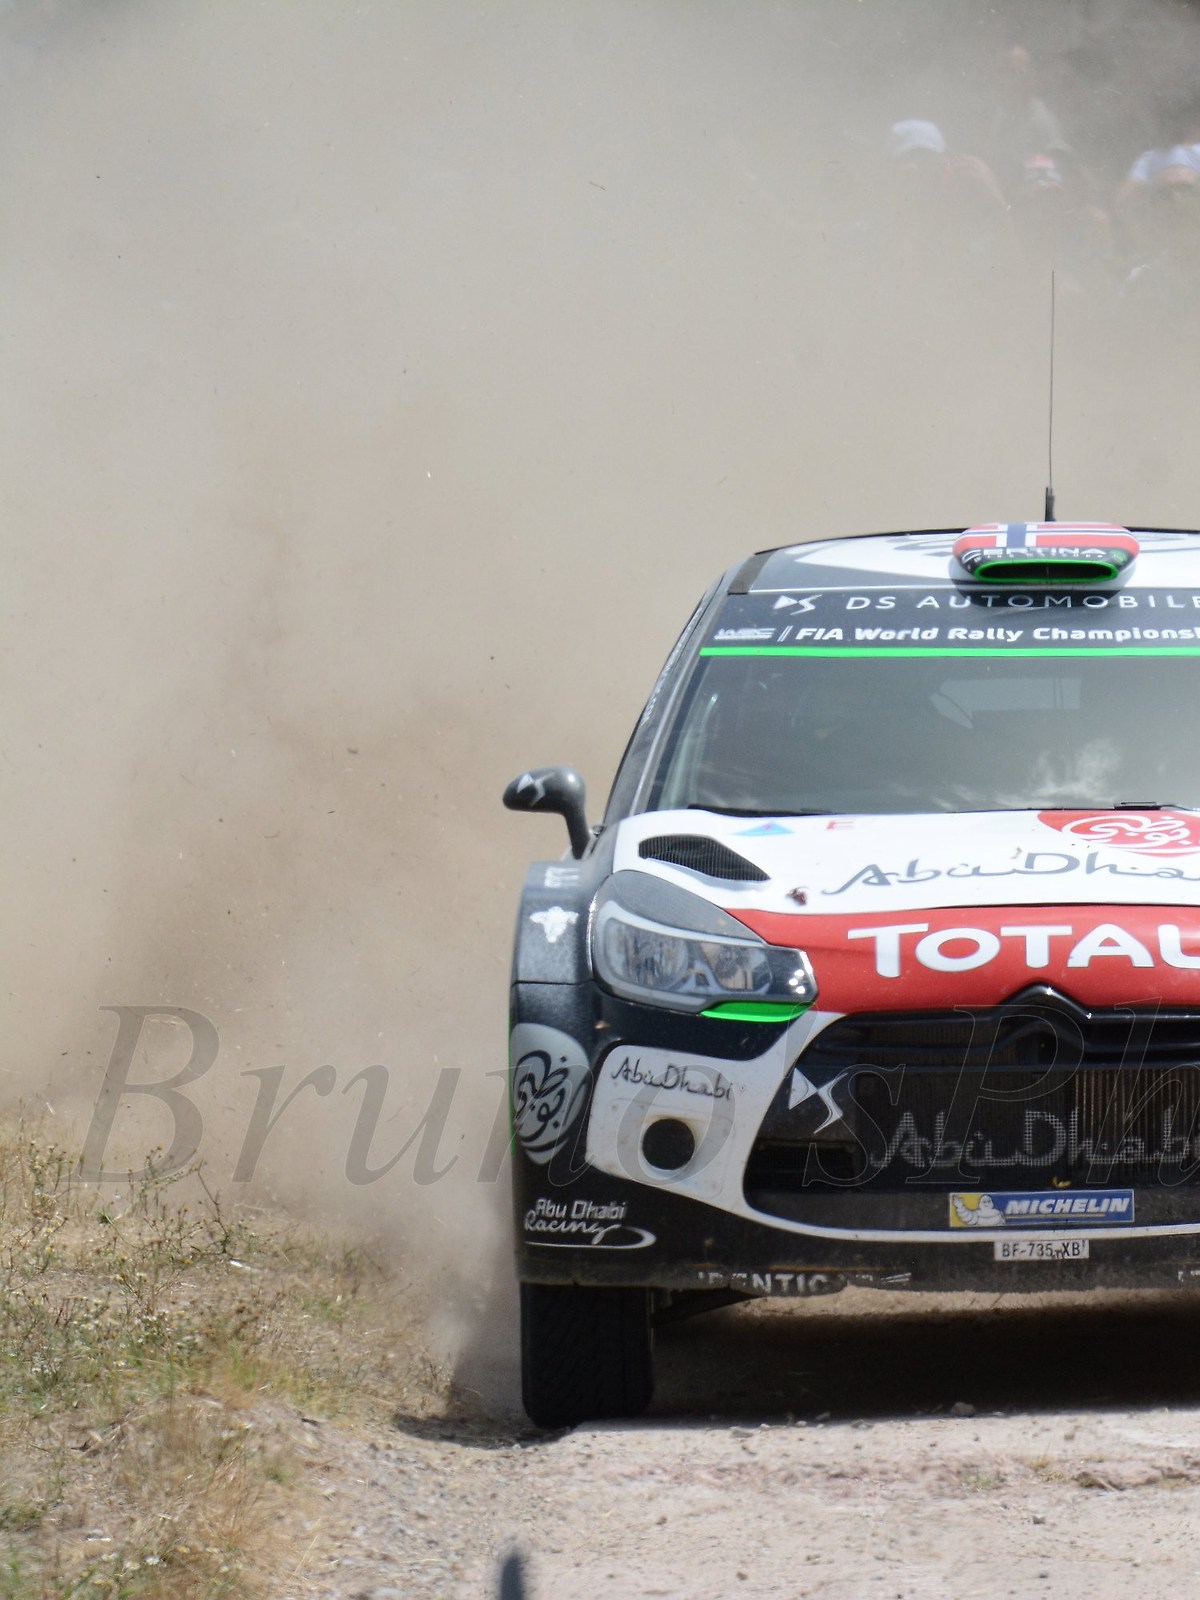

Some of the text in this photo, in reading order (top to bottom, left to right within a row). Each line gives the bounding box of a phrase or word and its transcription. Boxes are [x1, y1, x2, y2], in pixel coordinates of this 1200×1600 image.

[846, 595, 896, 610] DS
[795, 627, 843, 641] FIA
[854, 626, 939, 641] World
[947, 626, 1023, 642] Rally
[535, 1198, 628, 1220] Abu Dhabi
[1004, 1197, 1130, 1214] MICHELIN
[523, 1210, 622, 1245] Racing
